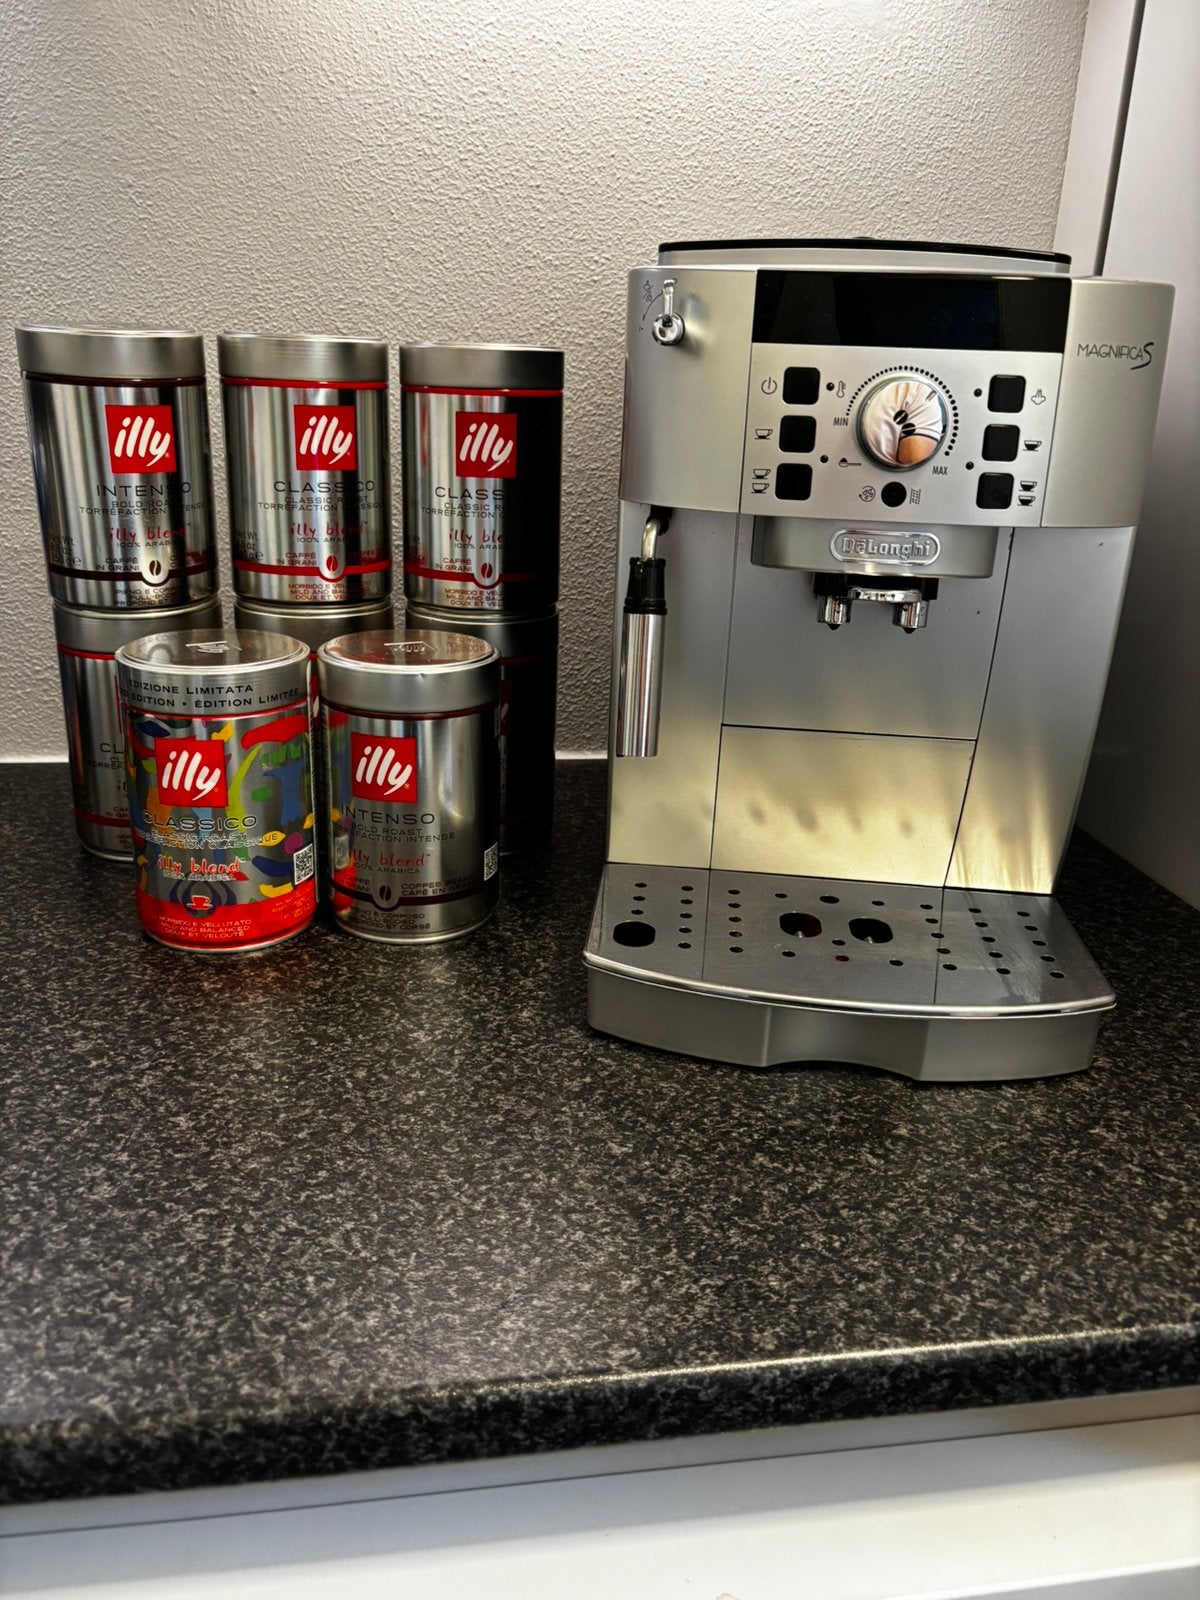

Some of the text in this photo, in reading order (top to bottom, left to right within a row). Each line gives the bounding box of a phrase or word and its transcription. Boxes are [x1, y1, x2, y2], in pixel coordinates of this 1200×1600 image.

[833, 417, 849, 427] MIN
[114, 415, 171, 467] illy
[300, 415, 353, 465] illy
[459, 422, 514, 472] illy
[932, 466, 948, 475] MAX
[97, 482, 192, 498] INTENSO
[111, 501, 143, 509] BOLD
[284, 496, 333, 504] CLASSIC
[444, 502, 490, 511] CLASSIC
[108, 527, 137, 544] illy
[289, 523, 316, 538] illy
[449, 529, 473, 543] illy
[107, 564, 140, 572] GRANI
[444, 564, 472, 572] GRANI
[129, 679, 180, 694] EDIZIONE
[186, 684, 254, 695] LIMITATA
[131, 691, 175, 707] EDITION
[195, 697, 252, 708] ÉDITION
[258, 687, 300, 705] LIMITÉE
[162, 750, 221, 801] illy
[355, 745, 413, 796] illy
[143, 810, 257, 831] CLASSICO
[340, 803, 435, 825] INTENSO
[202, 831, 247, 842] ROAST
[351, 822, 423, 837] BOLD ROAST
[208, 833, 278, 850] CLASSIQUE
[406, 832, 456, 843] INTENSE
[157, 854, 240, 874] illy blend
[379, 851, 425, 867] blend
[377, 866, 421, 874] ARABICA
[401, 881, 441, 890] COFFEE
[432, 887, 446, 895] EN
[200, 918, 252, 928] VELLUTATO
[381, 912, 426, 920] CORPOSO
[199, 925, 251, 933] BALANCED
